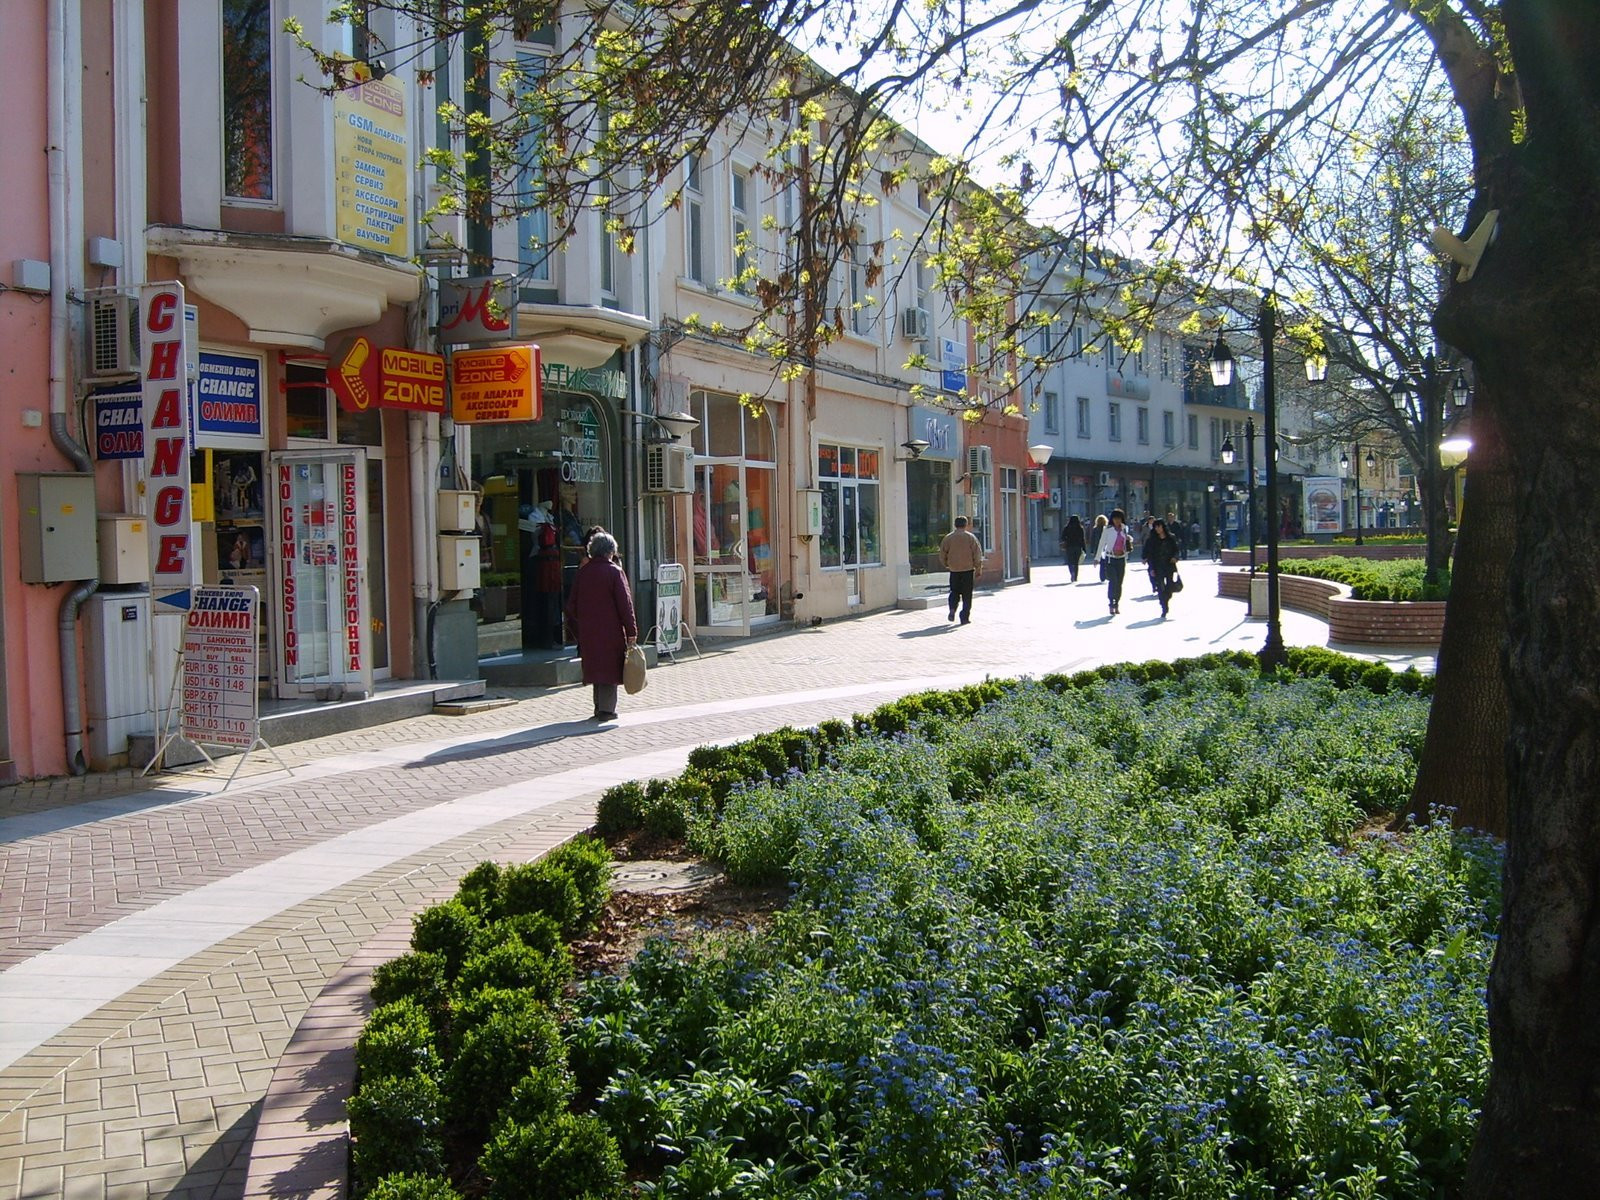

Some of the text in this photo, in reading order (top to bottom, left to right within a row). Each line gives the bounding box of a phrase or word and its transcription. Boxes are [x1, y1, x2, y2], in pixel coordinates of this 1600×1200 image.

[349, 113, 404, 144] GSM АПАРАТИ
[354, 160, 386, 178] ЗАМЯНА
[354, 176, 384, 191] СЕРВИЗ
[355, 189, 399, 209] АКСЕСОАРИ
[355, 203, 404, 225] СТАРТИРАЩИ
[366, 217, 395, 233] ПАКЕТИ
[356, 228, 390, 245] ВАУЧЪРИ
[200, 362, 234, 376] ОБМЕННО
[234, 365, 256, 378] БЮРО
[200, 377, 255, 399] CHANGE
[460, 389, 524, 401] GSM АПАРАТИ
[465, 400, 519, 411] АКСЕСОАРИ
[475, 410, 510, 421] СЕРВИЗ
[146, 291, 189, 575] CHANGE
[343, 465, 356, 512] БЕЗ
[279, 465, 297, 667] NO COMISSION
[187, 611, 251, 630] ОЛИМП
[206, 636, 247, 645] БАНКНОТИ
[185, 661, 245, 675] EUR 1.95 1.96
[184, 675, 200, 687] USD
[226, 678, 245, 691] 1.48
[184, 689, 199, 700] GBP
[184, 703, 199, 714] CHF
[185, 716, 199, 727] TRL
